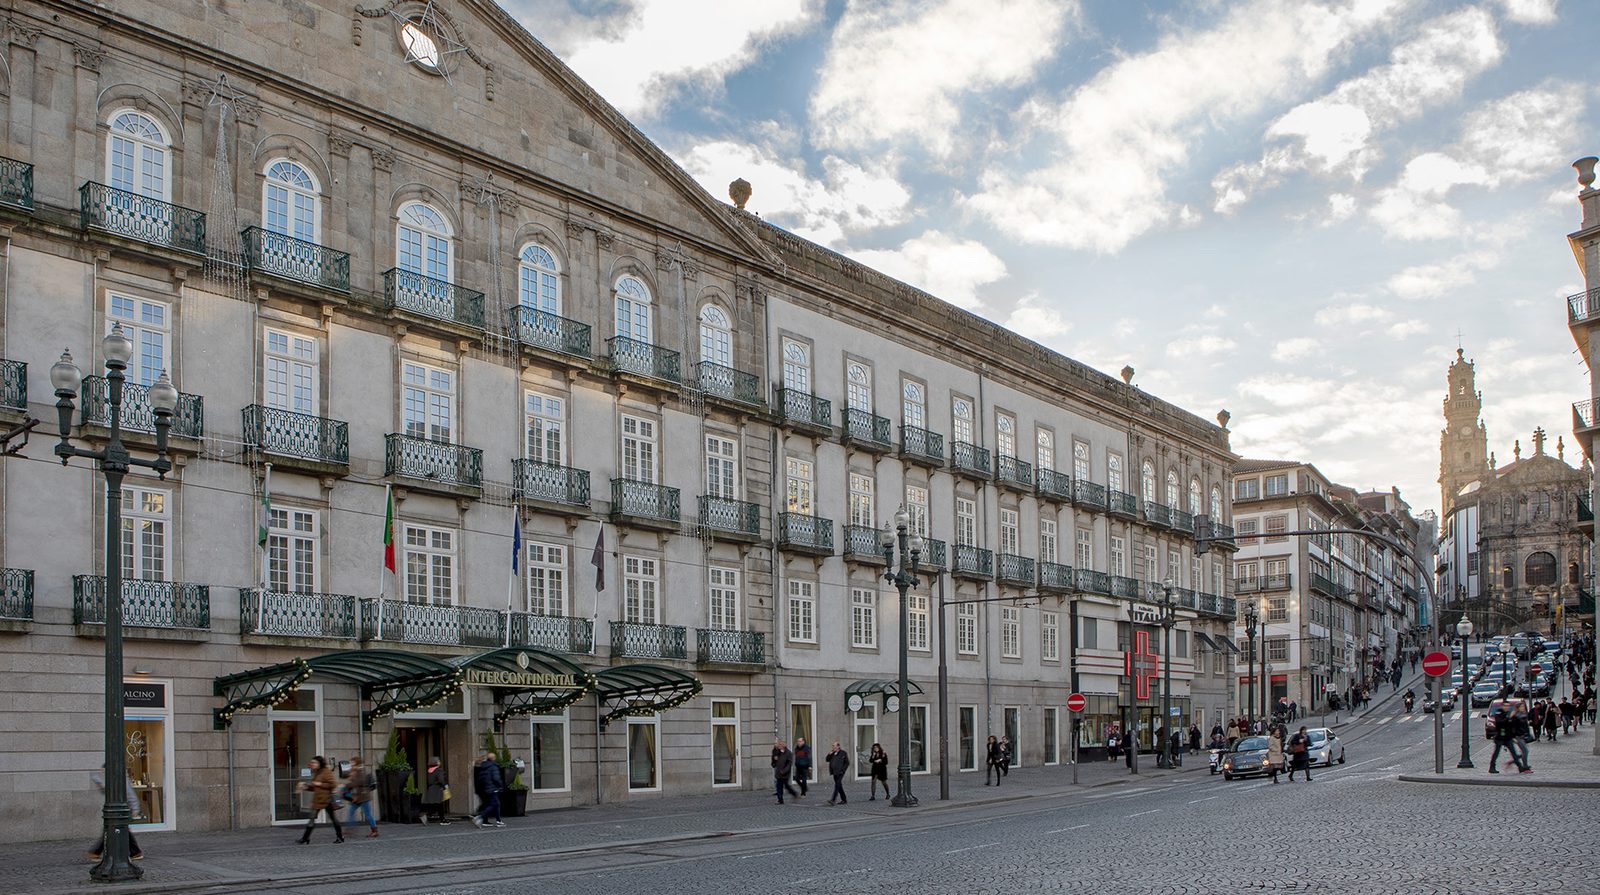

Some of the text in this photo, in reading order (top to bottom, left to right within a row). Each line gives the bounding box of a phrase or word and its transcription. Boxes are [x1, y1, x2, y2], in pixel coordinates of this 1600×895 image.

[1127, 609, 1164, 624] VITALI
[466, 668, 577, 686] INTERCONTINENTAL
[123, 690, 155, 698] ALCINO
